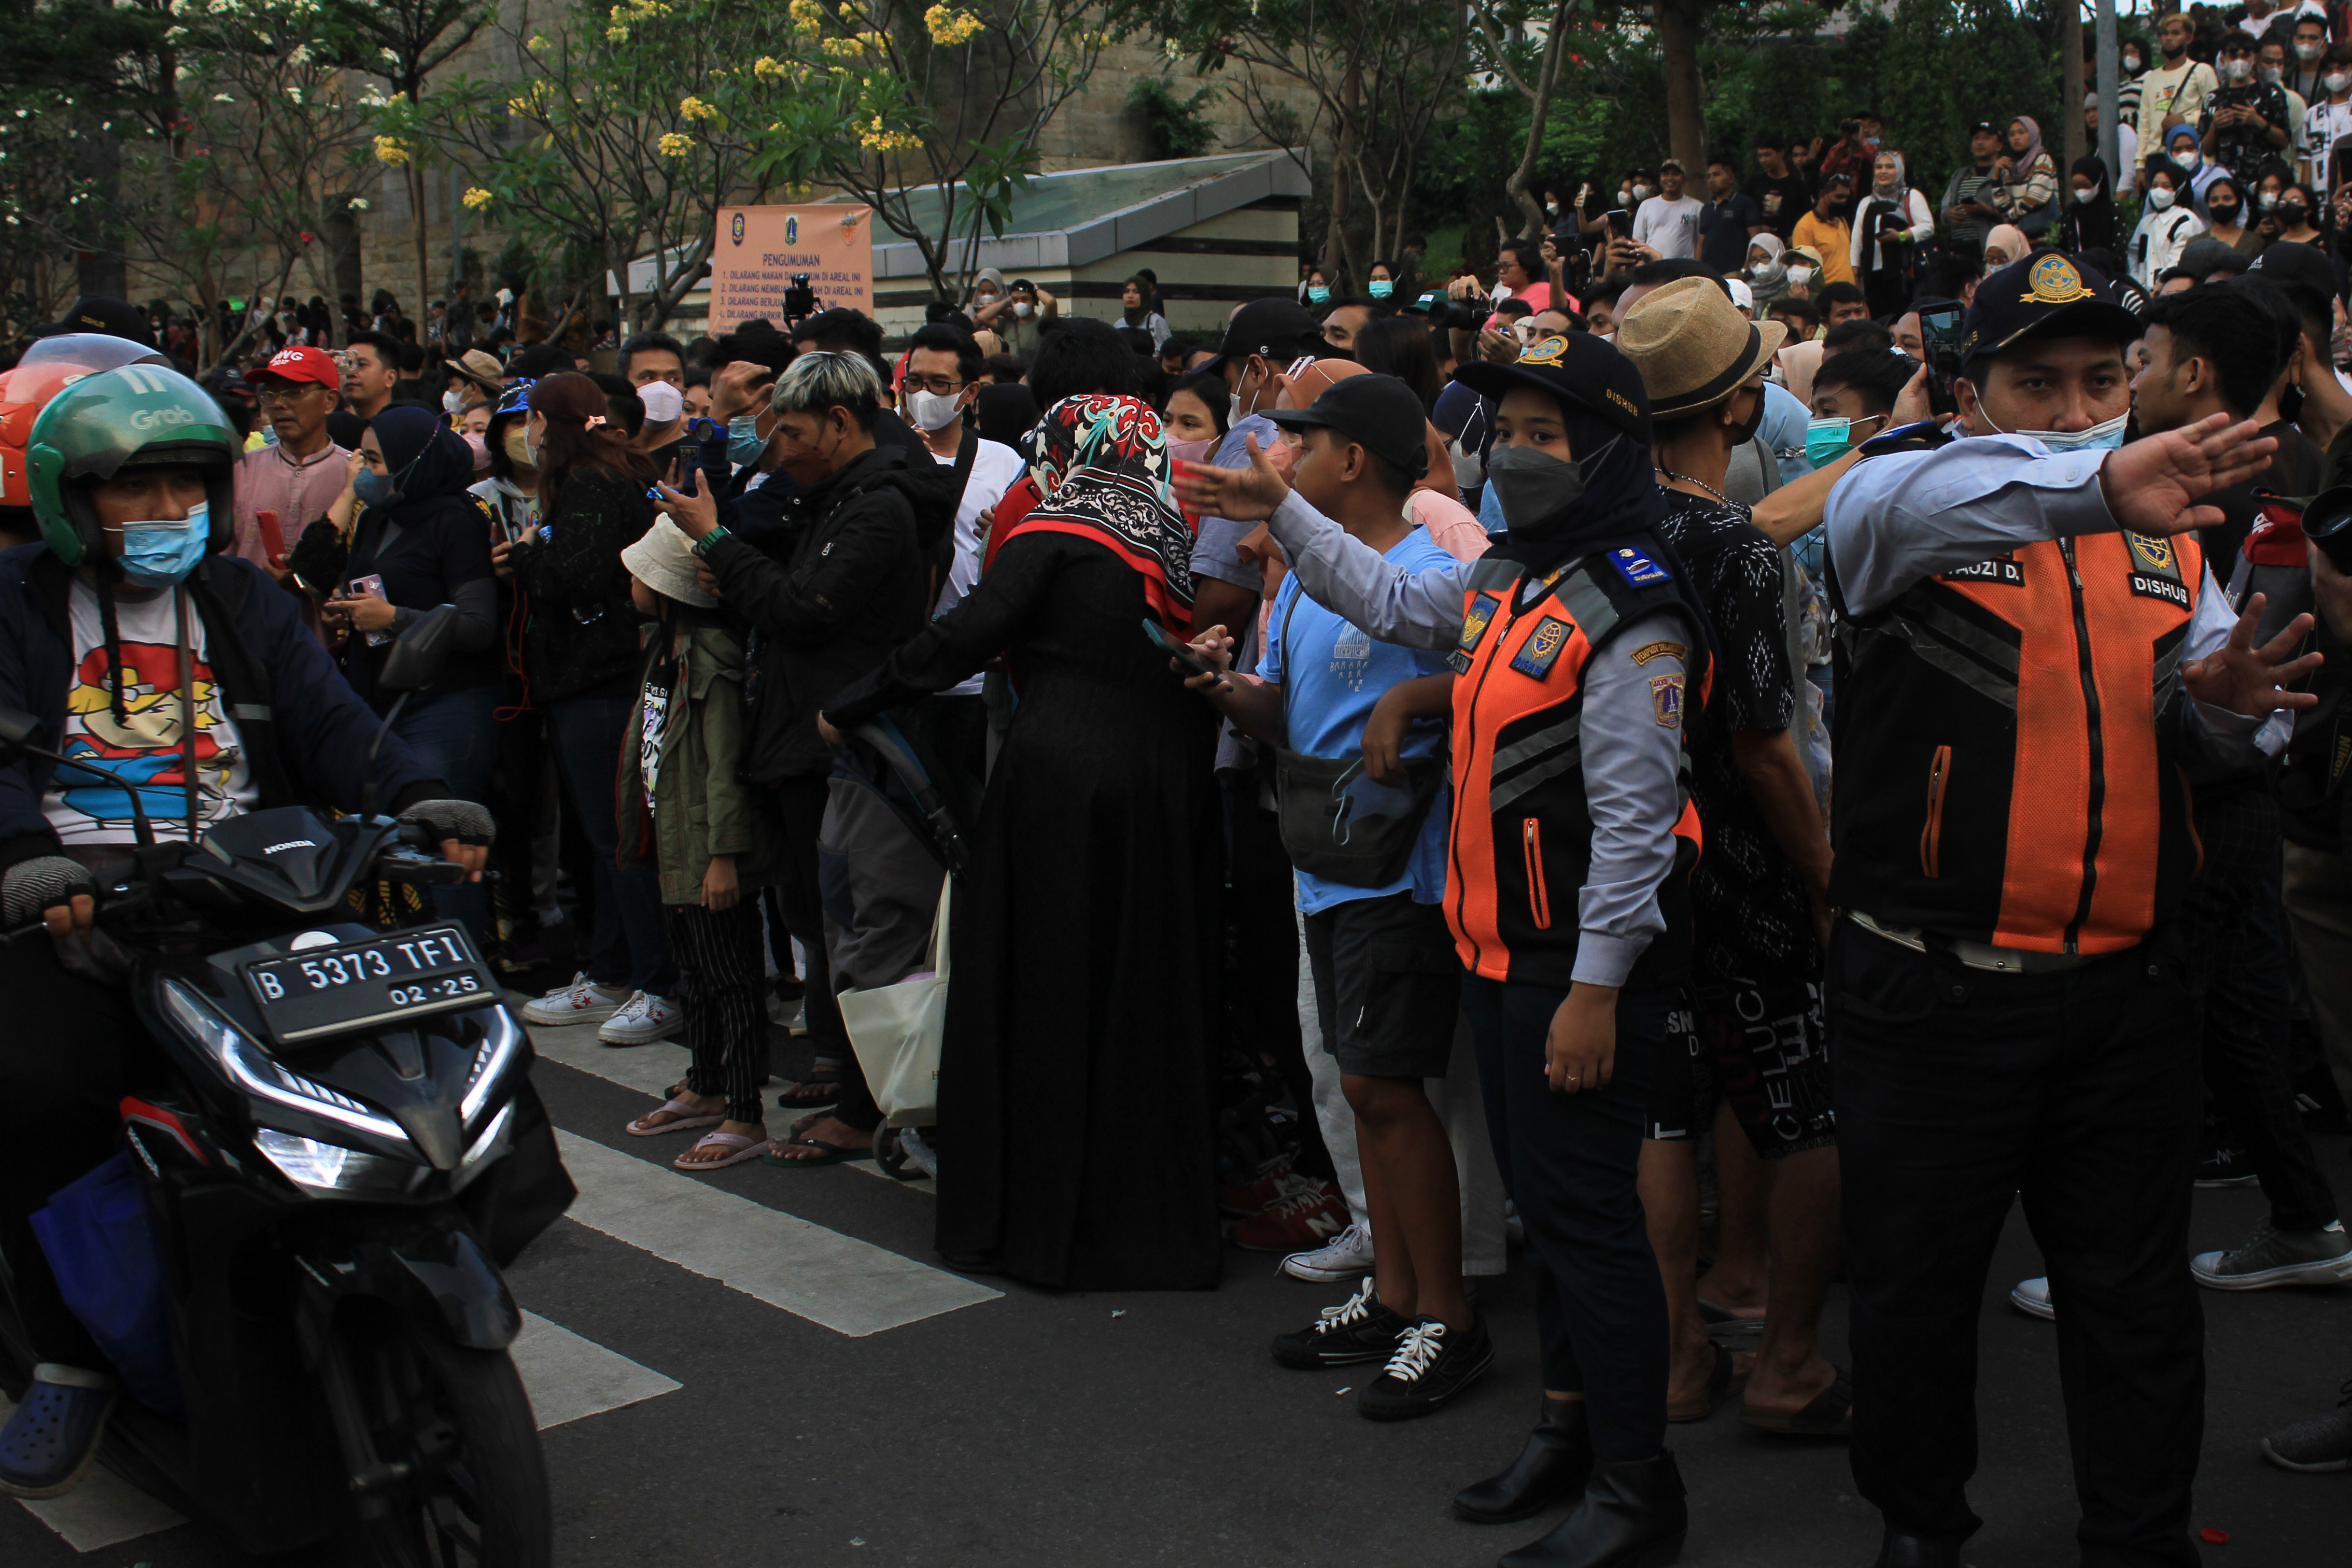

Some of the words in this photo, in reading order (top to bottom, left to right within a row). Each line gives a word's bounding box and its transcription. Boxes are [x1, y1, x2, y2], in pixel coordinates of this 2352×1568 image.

[763, 253, 820, 266] PENGUMUMAN
[730, 271, 759, 279] DILARANG
[762, 271, 783, 280] MAKAN
[822, 272, 828, 280] DI
[830, 273, 850, 281] AREAL
[852, 273, 860, 281] INI
[721, 284, 726, 292] 2.
[729, 284, 759, 292] DILARANG
[832, 287, 853, 295] AREAL
[854, 287, 863, 295] INI
[720, 296, 726, 305] 3.
[728, 296, 758, 306] DILARANG
[828, 300, 837, 308] INI
[727, 309, 757, 319] DILARANG
[759, 310, 781, 320] PARKIR
[1607, 388, 1638, 417] DISHUB
[130, 404, 196, 430] Grab
[1948, 561, 1997, 577] AUZI
[2005, 564, 2020, 581] D.
[2134, 577, 2187, 604] DISHUB
[2333, 734, 2352, 778] Nikon
[262, 840, 317, 855] HONDA
[258, 972, 285, 999] B
[300, 950, 391, 989] 5373
[396, 936, 463, 969] TFI
